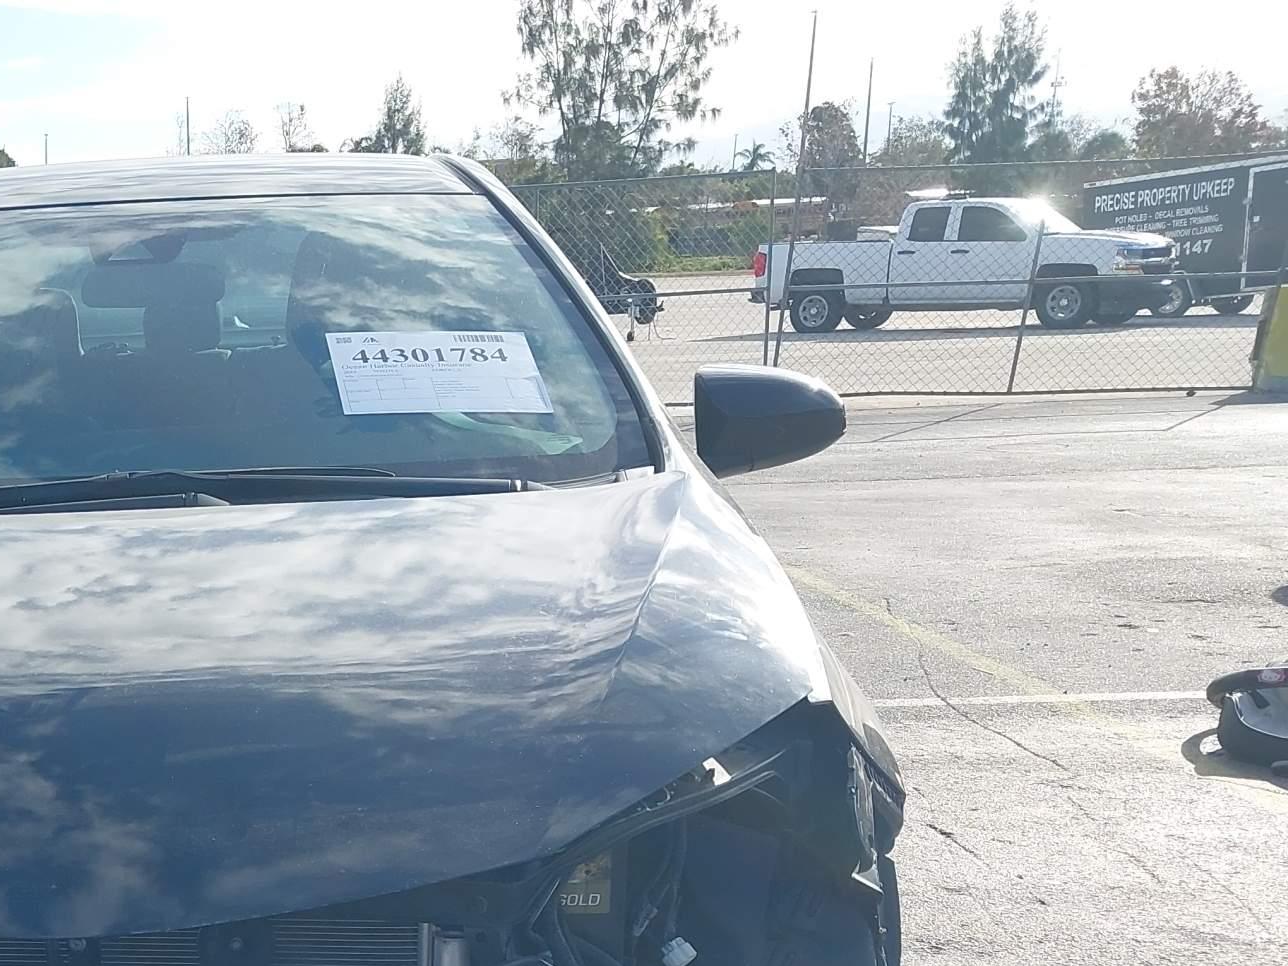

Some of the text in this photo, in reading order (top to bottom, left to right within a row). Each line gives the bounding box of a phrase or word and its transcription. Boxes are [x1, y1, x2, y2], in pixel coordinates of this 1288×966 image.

[1095, 178, 1235, 213] PRECISE PROPERTY UPKEEP
[1115, 216, 1127, 224] POT
[1128, 213, 1148, 223] HOLES
[1155, 210, 1175, 220] DECAL
[1176, 205, 1209, 217] REMOVALS
[1137, 221, 1167, 232] CLEANING
[1173, 218, 1188, 228] TREE
[1189, 214, 1220, 226] TRIMMING
[1192, 224, 1224, 235] CLEANING
[352, 347, 508, 364] 44301784
